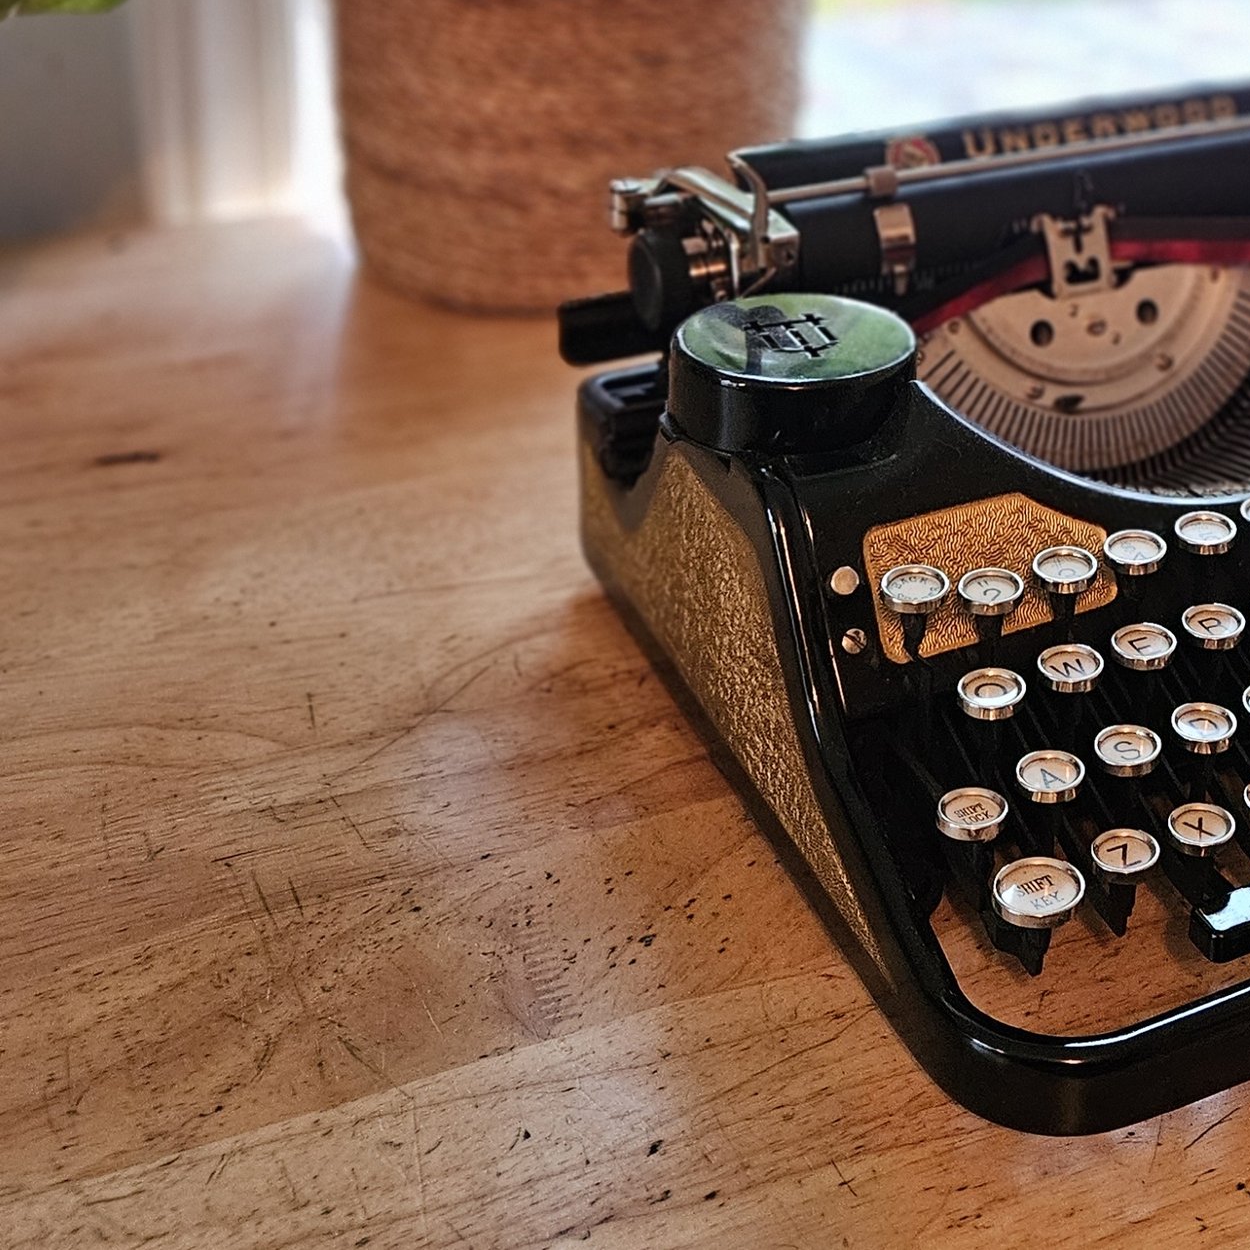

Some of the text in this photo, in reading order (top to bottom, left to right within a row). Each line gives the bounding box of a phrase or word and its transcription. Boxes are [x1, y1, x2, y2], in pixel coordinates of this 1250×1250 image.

[1050, 658, 1086, 678] W
[1114, 741, 1141, 760] S
[1040, 768, 1067, 789] A
[954, 802, 986, 819] SHIFT
[1183, 817, 1217, 840] X
[1106, 843, 1142, 867] Z
[1016, 874, 1055, 898] SHIFT
